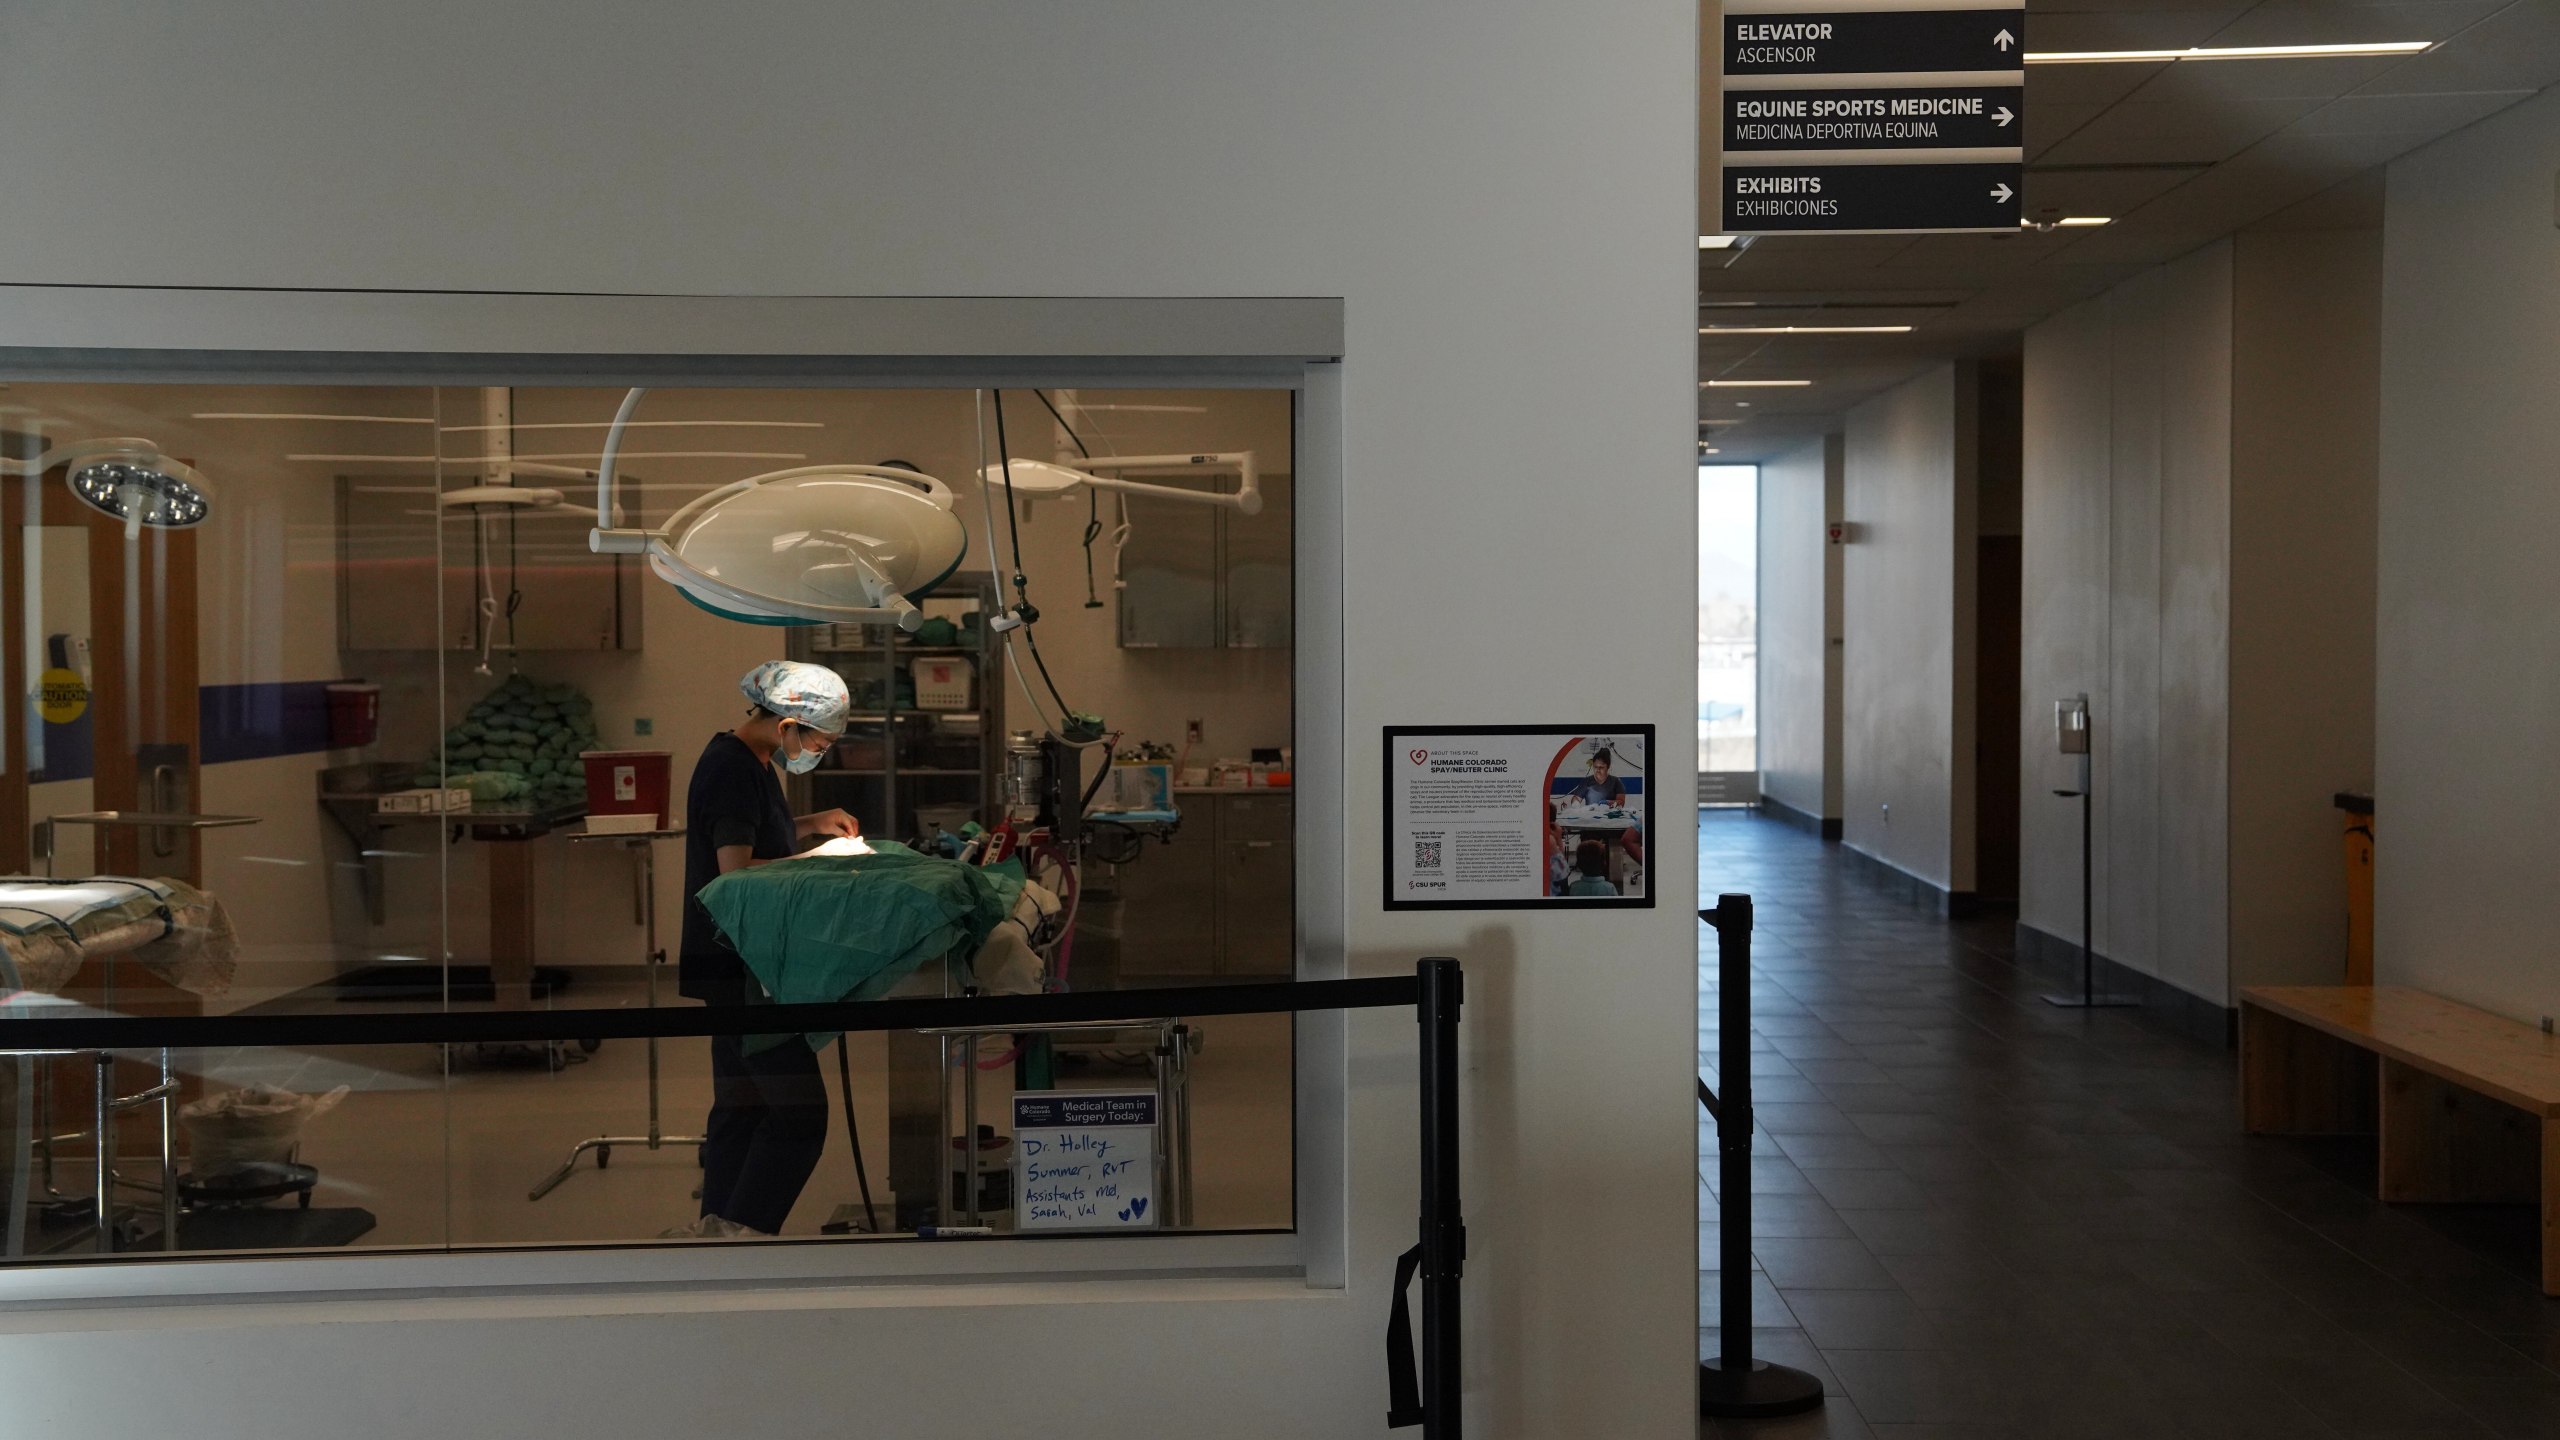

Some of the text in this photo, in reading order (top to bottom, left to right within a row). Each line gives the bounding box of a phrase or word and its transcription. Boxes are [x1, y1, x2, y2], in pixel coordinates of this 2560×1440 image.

[1737, 24, 1832, 41] ELEVATOR
[1737, 46, 1815, 63] ASCENSOR
[1737, 98, 1982, 118] EQUINE SPORTS MEDICINE
[1737, 122, 1938, 140] MEDICINA DEPORTIVA EQUINA
[1737, 177, 1821, 194] EXHIBITS
[1736, 200, 1837, 216] EXHIBICIONES
[32, 691, 87, 700] CAUTION
[1063, 1100, 1146, 1111] Medical Team in
[1065, 1112, 1144, 1123] Surgery Today:
[1022, 1134, 1116, 1158] Dr. Holley
[1028, 1160, 1135, 1182] Summer, RVT
[1026, 1185, 1085, 1203] Assistants
[1031, 1204, 1096, 1220] Sarah, Val
